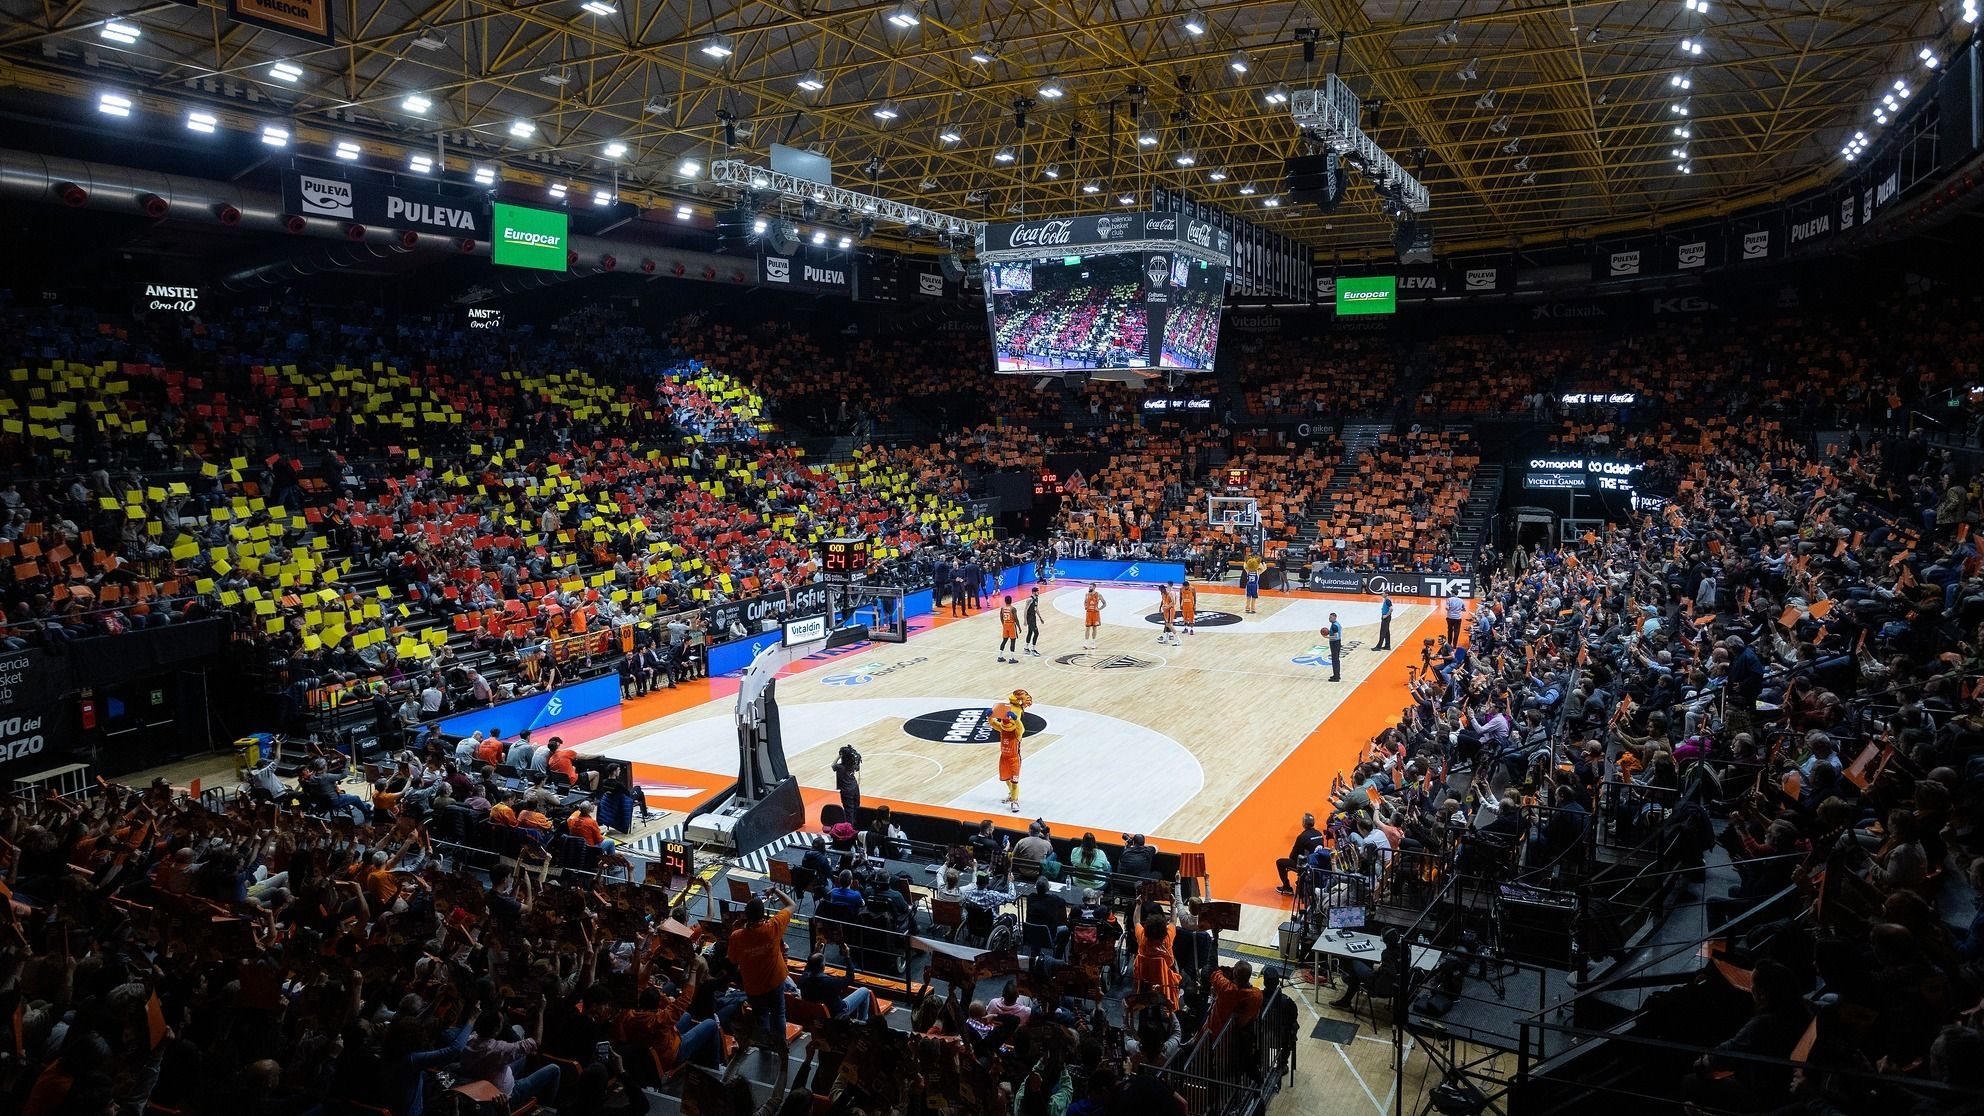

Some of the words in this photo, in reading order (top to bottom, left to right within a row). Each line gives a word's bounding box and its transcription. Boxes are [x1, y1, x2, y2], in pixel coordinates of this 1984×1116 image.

[304, 180, 350, 198] PULEVA
[387, 196, 476, 230] PULEVA
[1009, 219, 1074, 248] Coca-Cola
[1791, 214, 1830, 243] PULEVA
[504, 227, 560, 247] Europcar
[1745, 235, 1768, 245] PULEVA
[1680, 246, 1705, 256] PULEVA
[767, 259, 788, 269] PULEVA
[1612, 254, 1638, 263] PULEVA
[803, 265, 846, 285] PULEVA
[921, 275, 942, 285] PULEVA
[1467, 271, 1495, 279] PULEVA
[1318, 279, 1336, 287] PUL
[1397, 276, 1437, 289] LEVA
[145, 284, 199, 299] AMSTEL
[1343, 290, 1390, 300] Europcar
[1231, 314, 1281, 328] Vitaldin
[1228, 476, 1241, 485] 24
[1527, 478, 1557, 486] VICENTE
[1557, 478, 1585, 486] GANDIA
[827, 554, 845, 569] 24
[852, 553, 866, 568] 24
[1380, 581, 1418, 594] Midea
[1424, 577, 1471, 598] TKE
[791, 621, 821, 635] Vitaldin
[0, 656, 30, 673] encia
[0, 672, 24, 687] sket
[0, 687, 13, 701] ub
[0, 716, 22, 739] ra
[22, 715, 42, 732] del
[0, 734, 44, 763] erzo
[667, 842, 684, 854] 10:00
